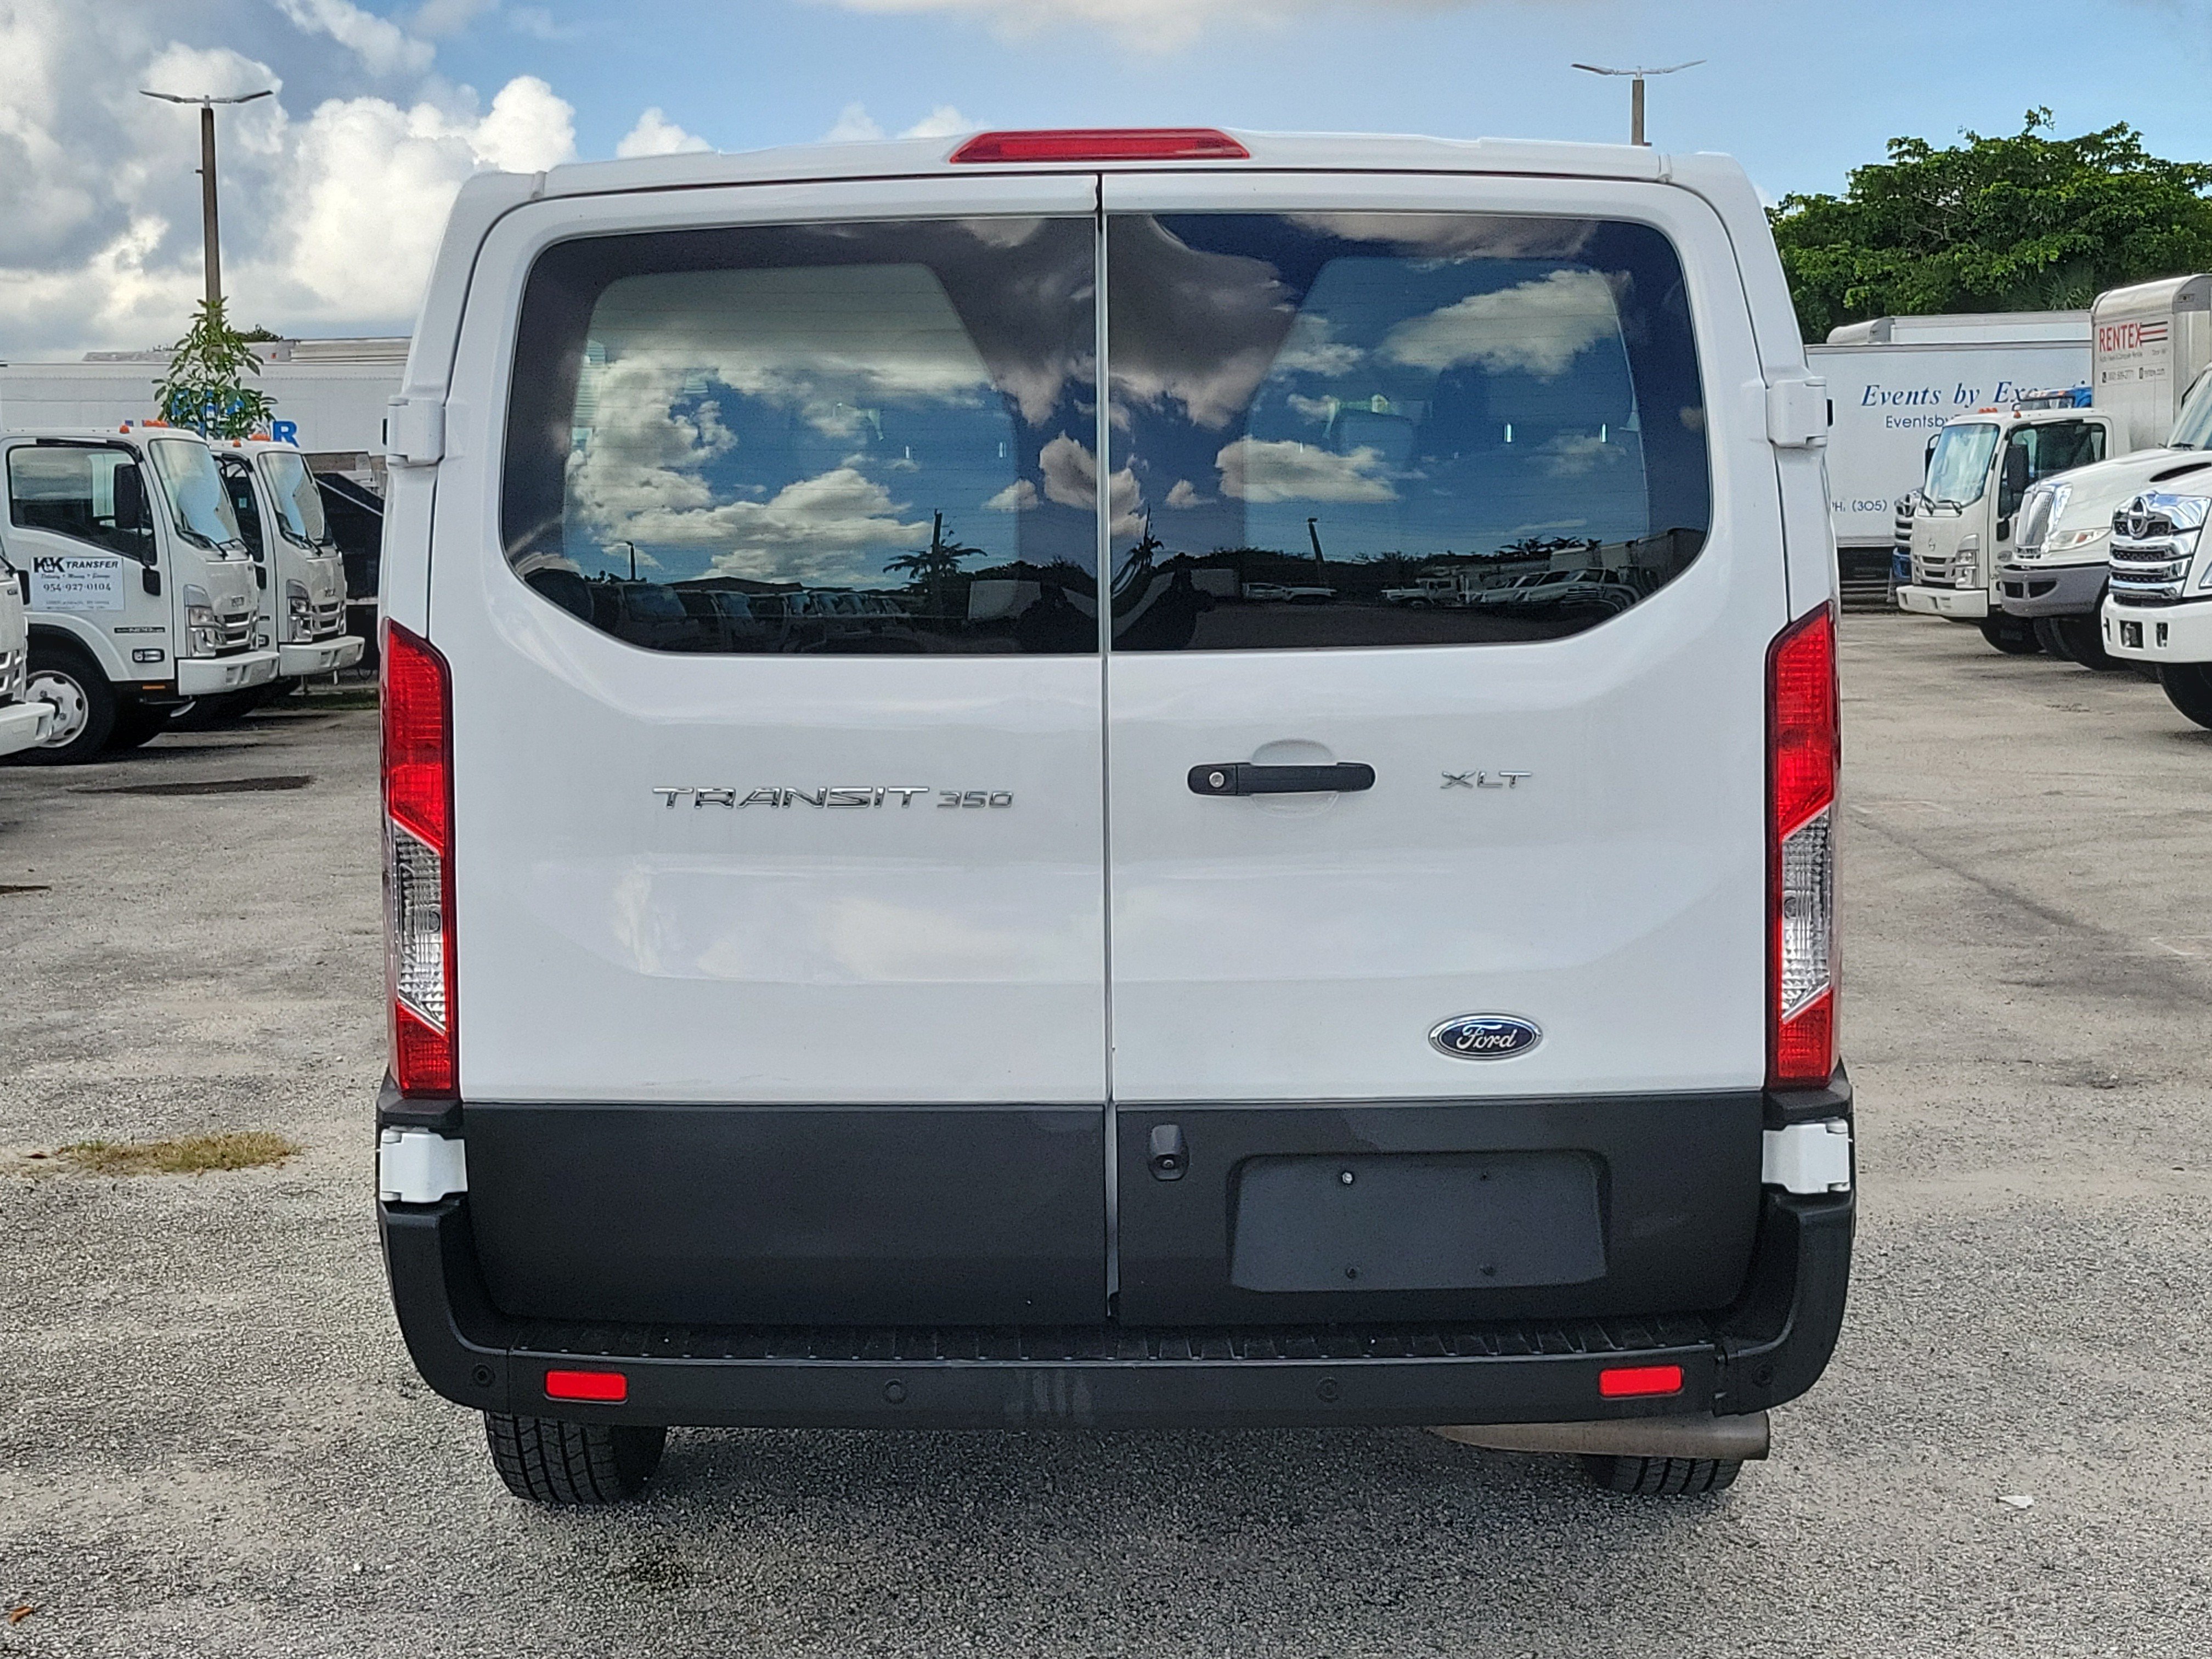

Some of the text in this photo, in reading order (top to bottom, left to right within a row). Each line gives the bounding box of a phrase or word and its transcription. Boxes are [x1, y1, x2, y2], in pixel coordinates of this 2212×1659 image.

[2099, 322, 2142, 352] RENTEX
[1861, 384, 1942, 407] Events
[1953, 382, 1980, 408] by
[1852, 499, 1887, 512] (305)
[1440, 771, 1532, 789] XLT
[652, 787, 1014, 809] TRANSIT 350
[1456, 1024, 1517, 1049] Ford
